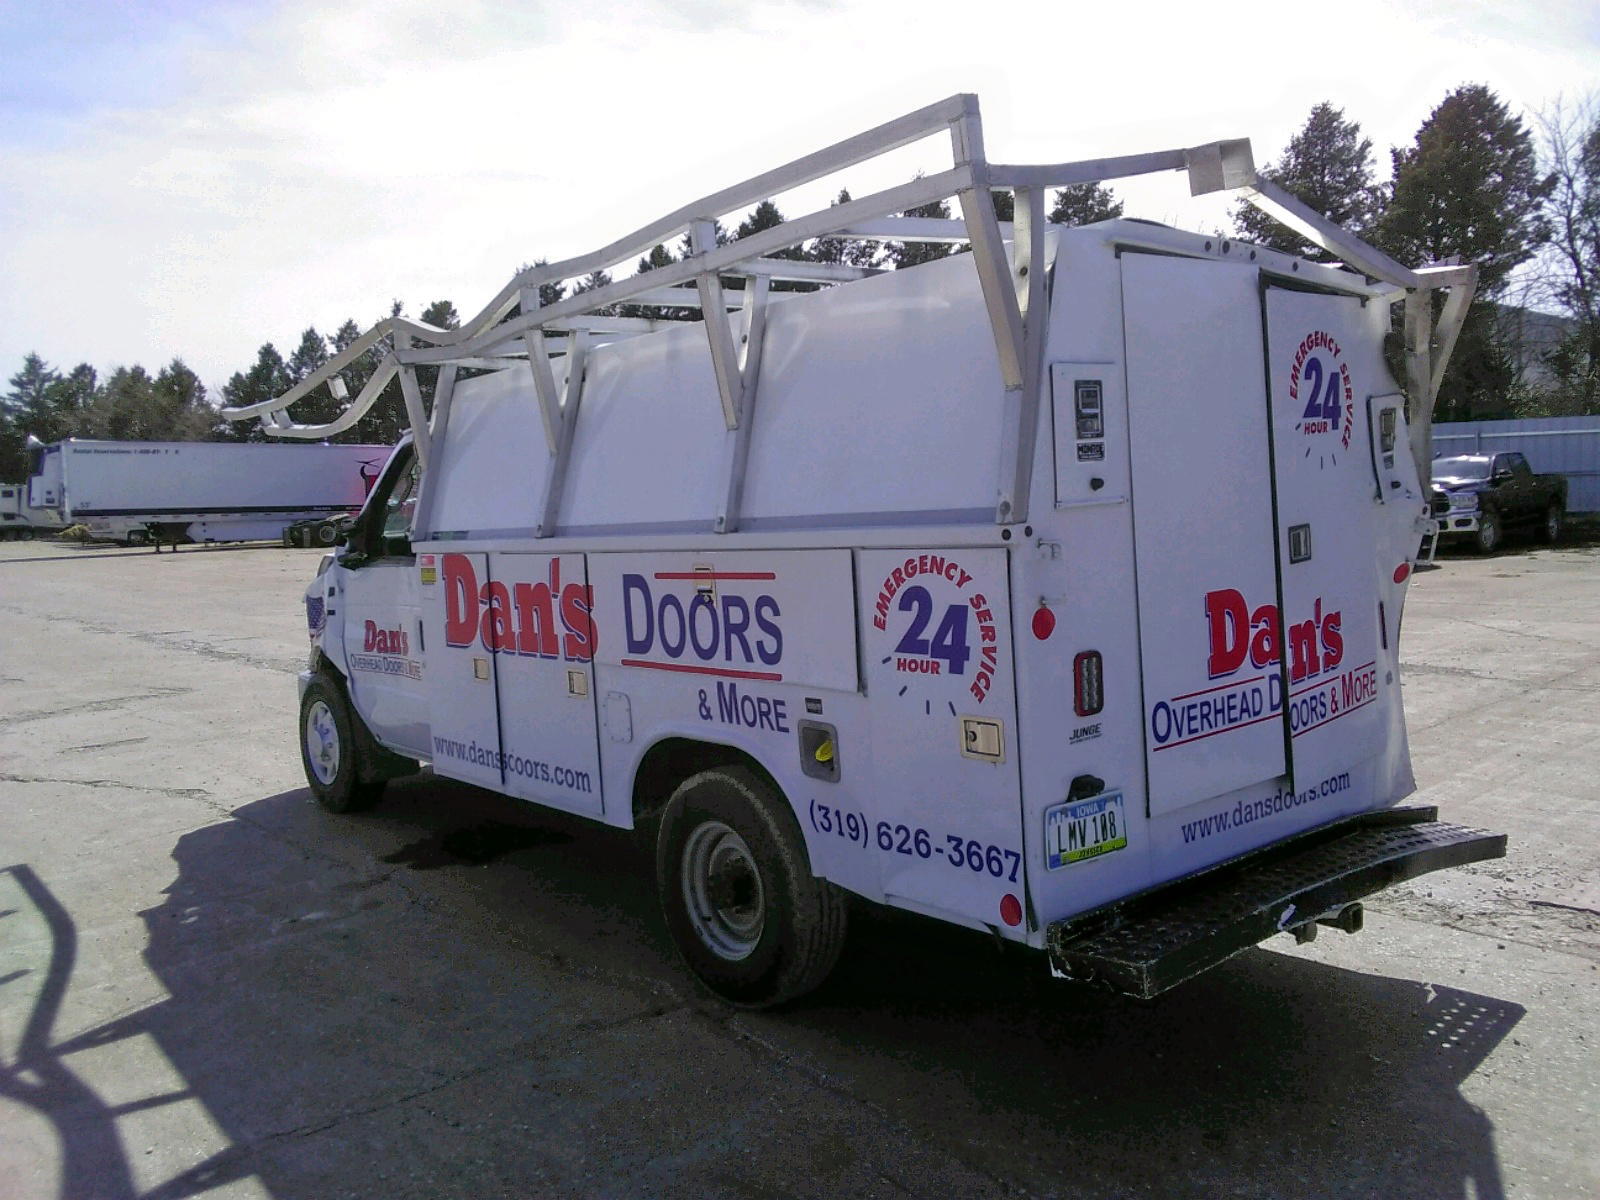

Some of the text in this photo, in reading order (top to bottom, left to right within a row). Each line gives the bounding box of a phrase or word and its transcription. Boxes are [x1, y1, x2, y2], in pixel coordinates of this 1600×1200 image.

[1289, 330, 1353, 451] EMERGENCY SERVICE
[1302, 357, 1341, 431] 24
[1304, 421, 1329, 435] HOUR
[364, 619, 409, 657] Dan's
[442, 552, 599, 663] Dan's
[622, 573, 784, 666] DOORS
[872, 554, 1000, 705] EMERGENCY SERVICE
[894, 585, 971, 676] 24
[1205, 588, 1344, 685] Dan's
[896, 657, 941, 676] HOUR
[698, 688, 713, 721] &
[717, 681, 790, 734] MORE
[1152, 670, 1377, 744] OVERHEAD DOORS & MORE
[808, 799, 1021, 884] (319) 626-3667
[1057, 818, 1087, 854] LMV
[1076, 802, 1100, 817] IOWA
